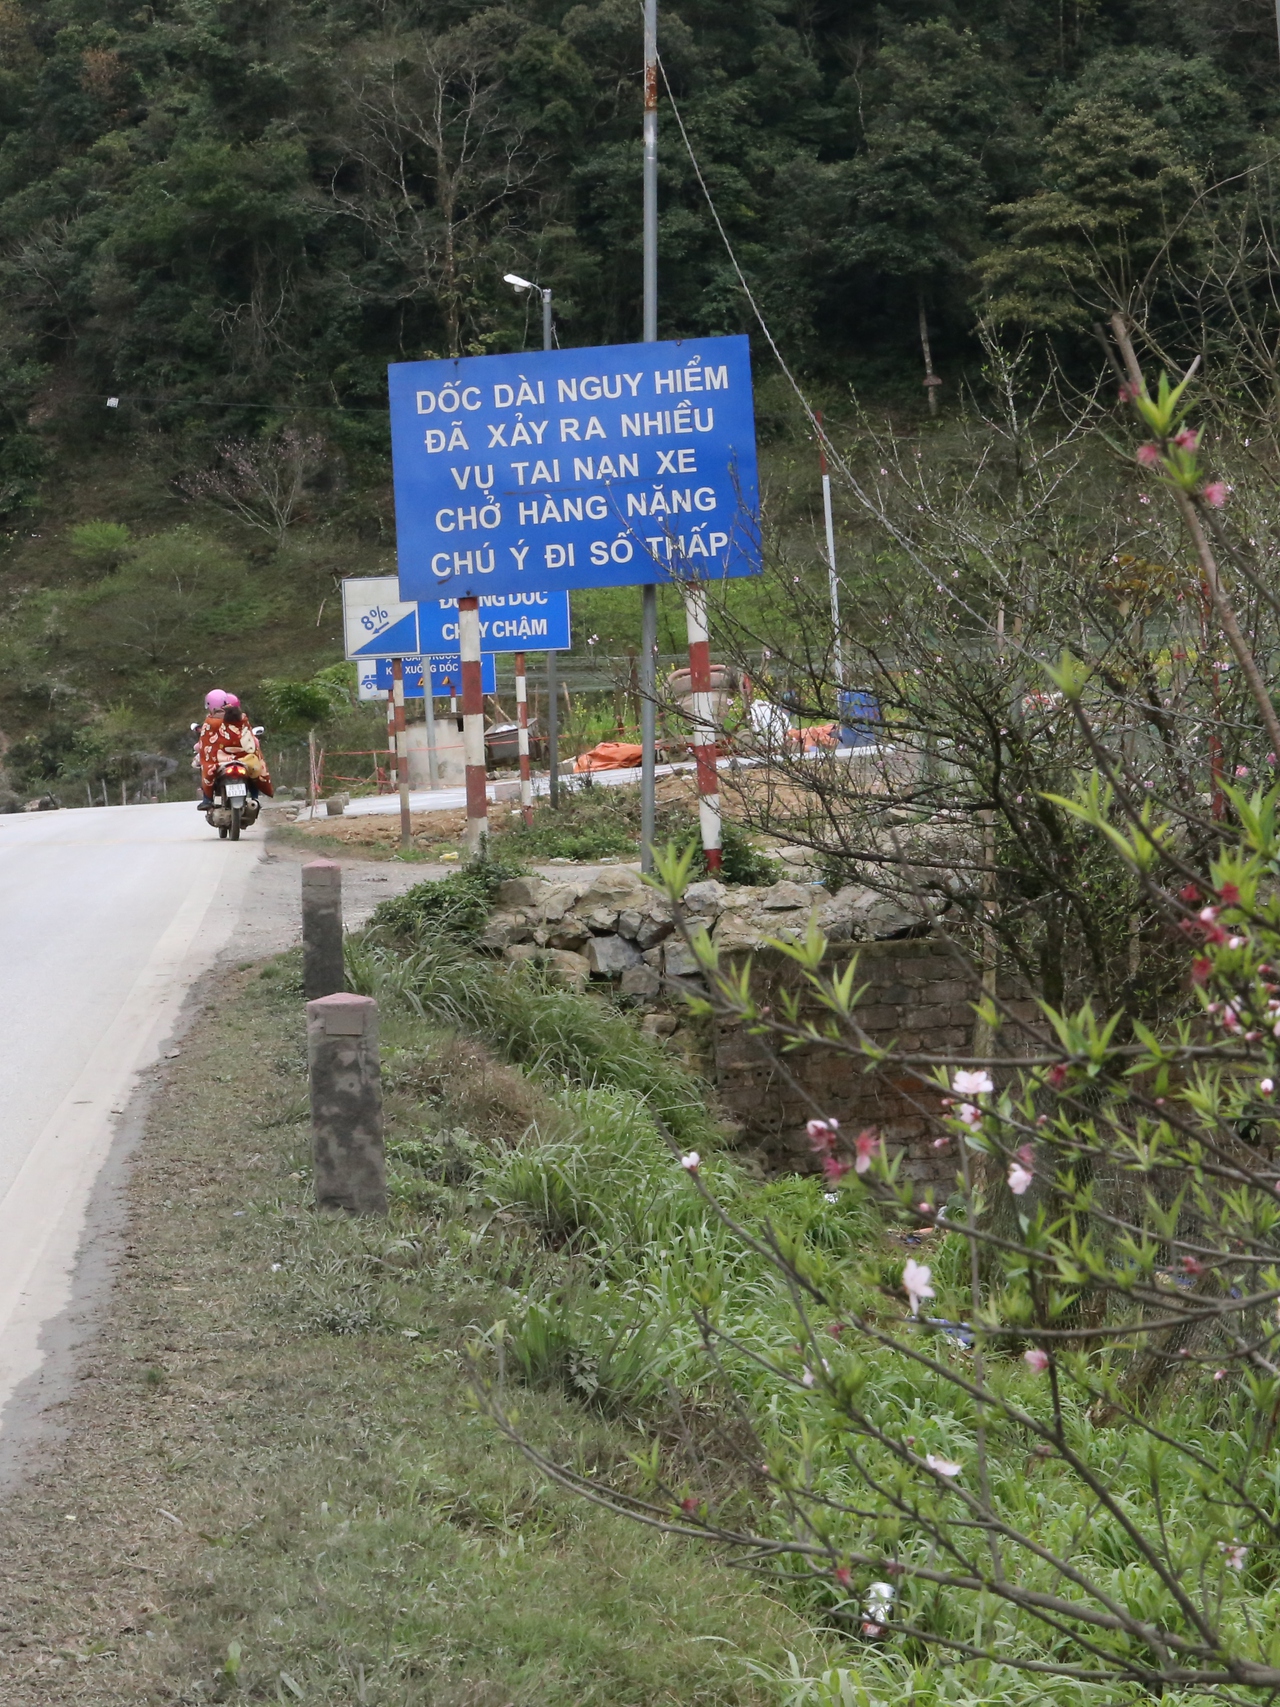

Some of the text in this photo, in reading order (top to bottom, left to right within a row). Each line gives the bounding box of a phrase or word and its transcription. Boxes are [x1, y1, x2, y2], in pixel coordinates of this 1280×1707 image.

[416, 354, 729, 415] DỐC DÀI NGUY HIỂM
[423, 399, 714, 454] ĐÃ XẢY RA NHIỀU
[450, 464, 494, 496] VỤ
[510, 458, 561, 486] TAI
[655, 448, 698, 475] XE
[435, 484, 717, 533] CHỞ HÀNG NẶNG
[431, 522, 729, 577] CHÚ Ý ĐI SỐ THẤP
[361, 605, 388, 630] 8%
[492, 615, 547, 639] CHẬM
[405, 663, 436, 674] XUỐG
[439, 660, 458, 672] DỐC
